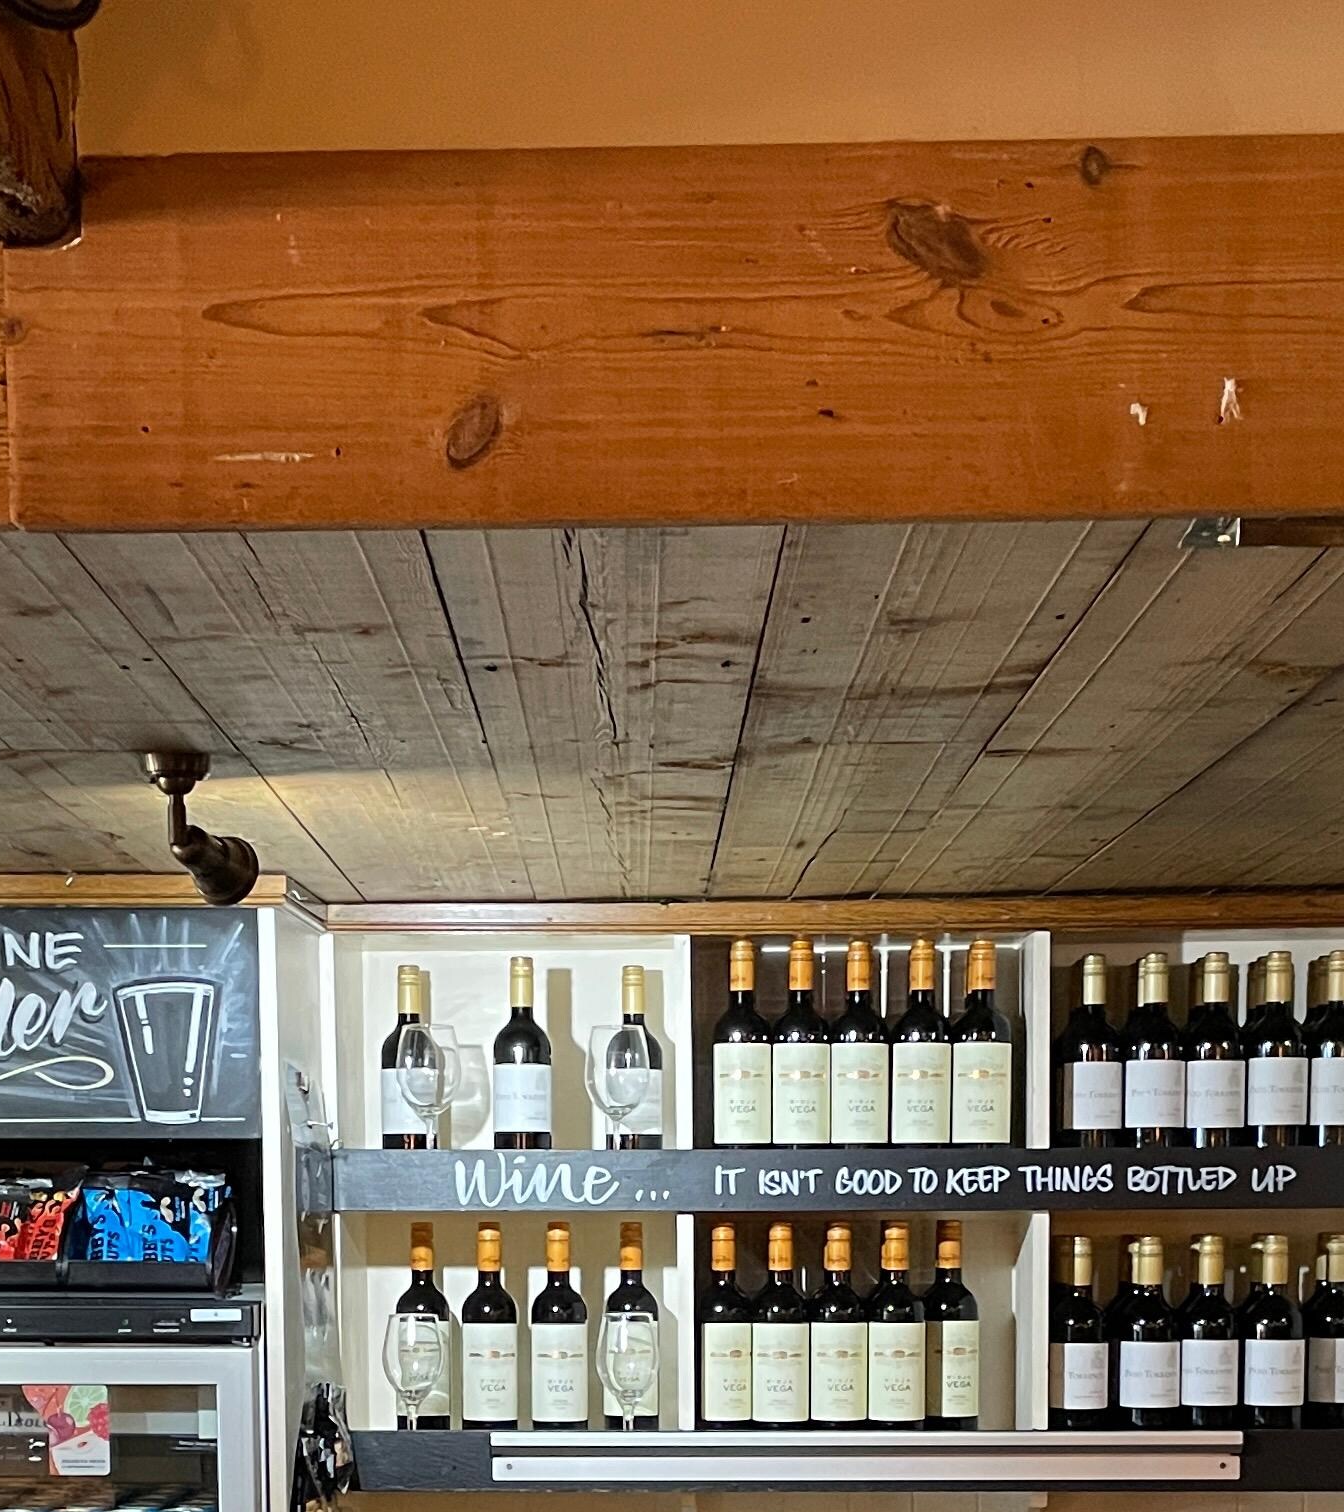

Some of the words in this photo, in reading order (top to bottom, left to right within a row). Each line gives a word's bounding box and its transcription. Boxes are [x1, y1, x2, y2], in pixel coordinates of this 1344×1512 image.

[714, 1165, 746, 1195] IT
[758, 1167, 824, 1196] ISN'T
[835, 1166, 903, 1195] GOOD
[907, 1166, 939, 1194] TO
[944, 1164, 1011, 1196] KEEP
[1018, 1164, 1114, 1194] THINGS
[1127, 1165, 1238, 1195] BOTTLED
[1251, 1164, 1298, 1193] UP
